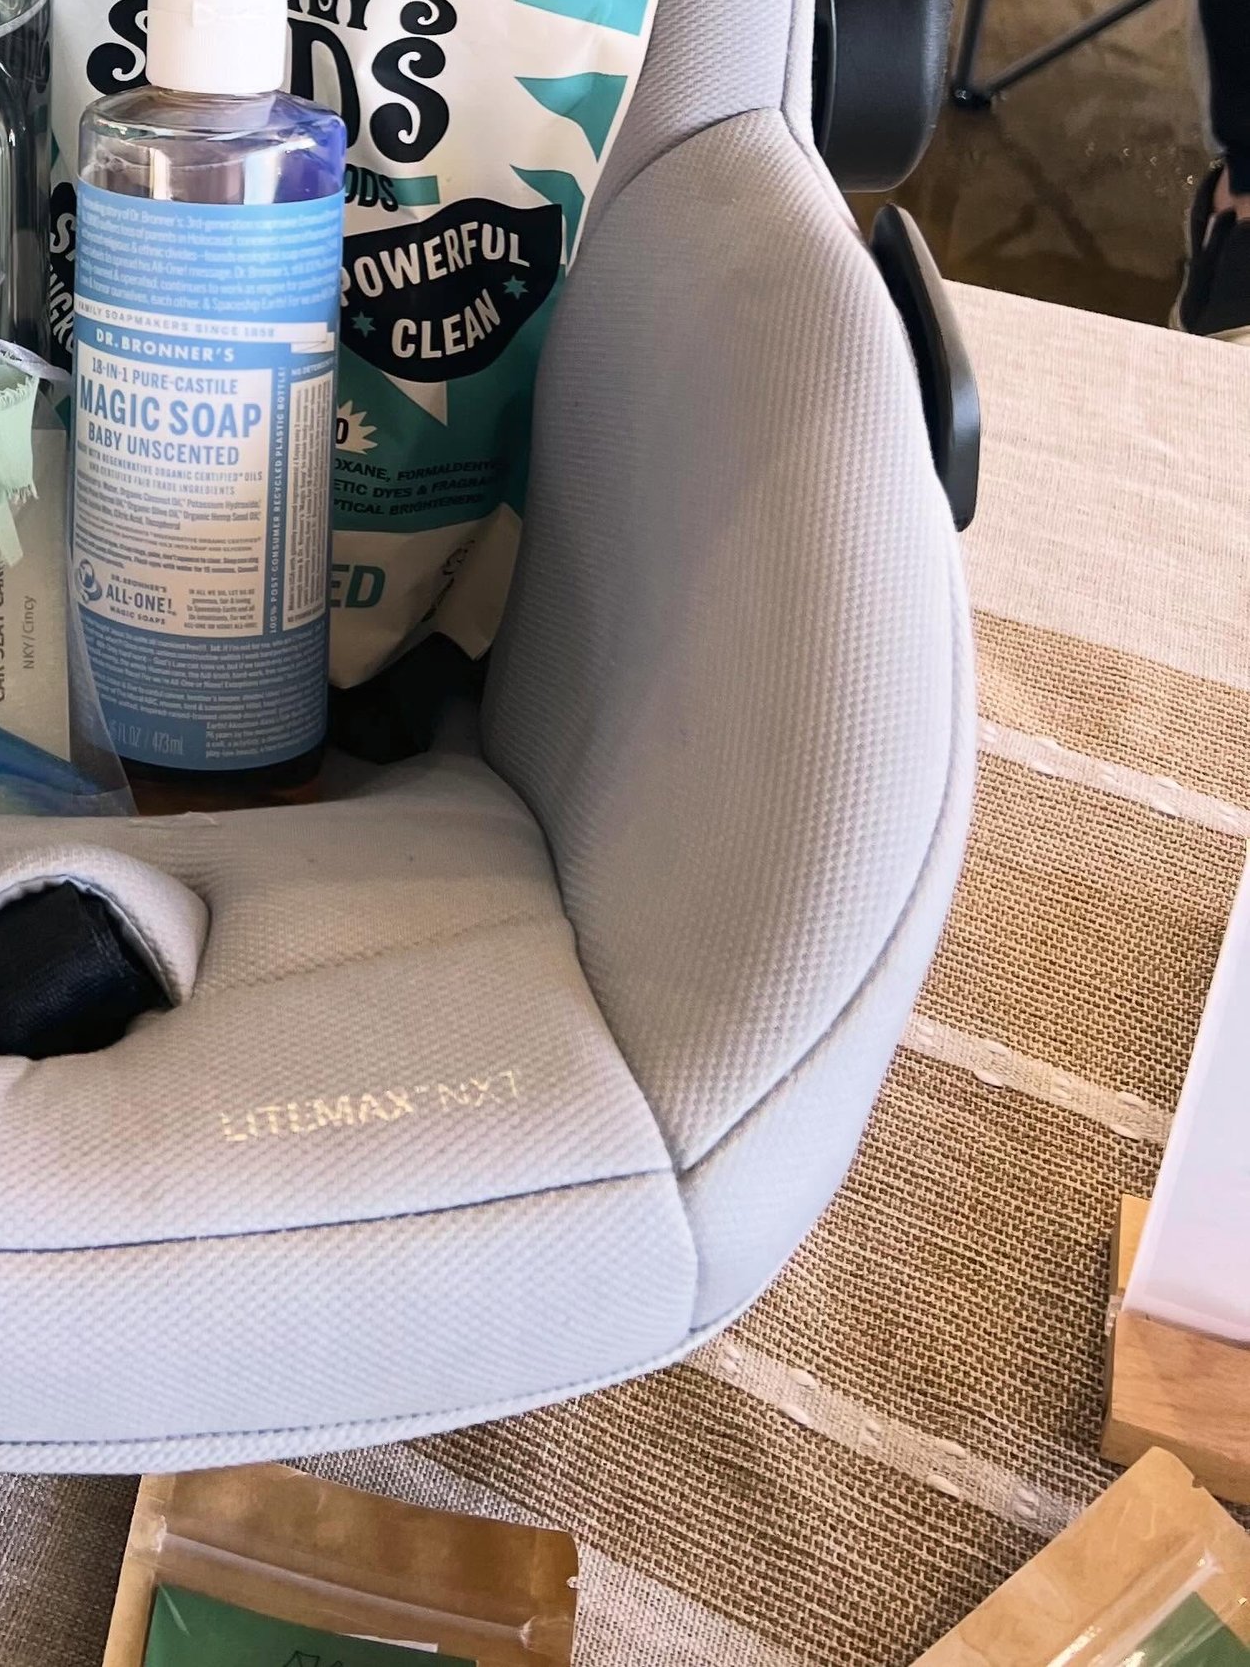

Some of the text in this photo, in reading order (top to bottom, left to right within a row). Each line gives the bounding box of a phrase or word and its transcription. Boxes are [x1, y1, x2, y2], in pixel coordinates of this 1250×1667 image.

[105, 309, 190, 332] SOAPMAKERS
[391, 288, 501, 359] CLEAN
[96, 327, 236, 362] DR. BRONNER'S
[92, 356, 238, 395] 18-IN-1 PURE-CASTILE
[79, 373, 262, 438] MAGIC SOAP
[88, 421, 122, 451] BABY
[127, 434, 239, 465] UNSCENTED
[275, 414, 285, 456] PLASTIC
[154, 466, 191, 481] ORGANIC
[179, 483, 235, 495] INGREDIENTS
[273, 460, 282, 512] RECYCLED
[105, 583, 172, 614] ALL-ONE!
[109, 604, 166, 625] MAGIC SOAPS
